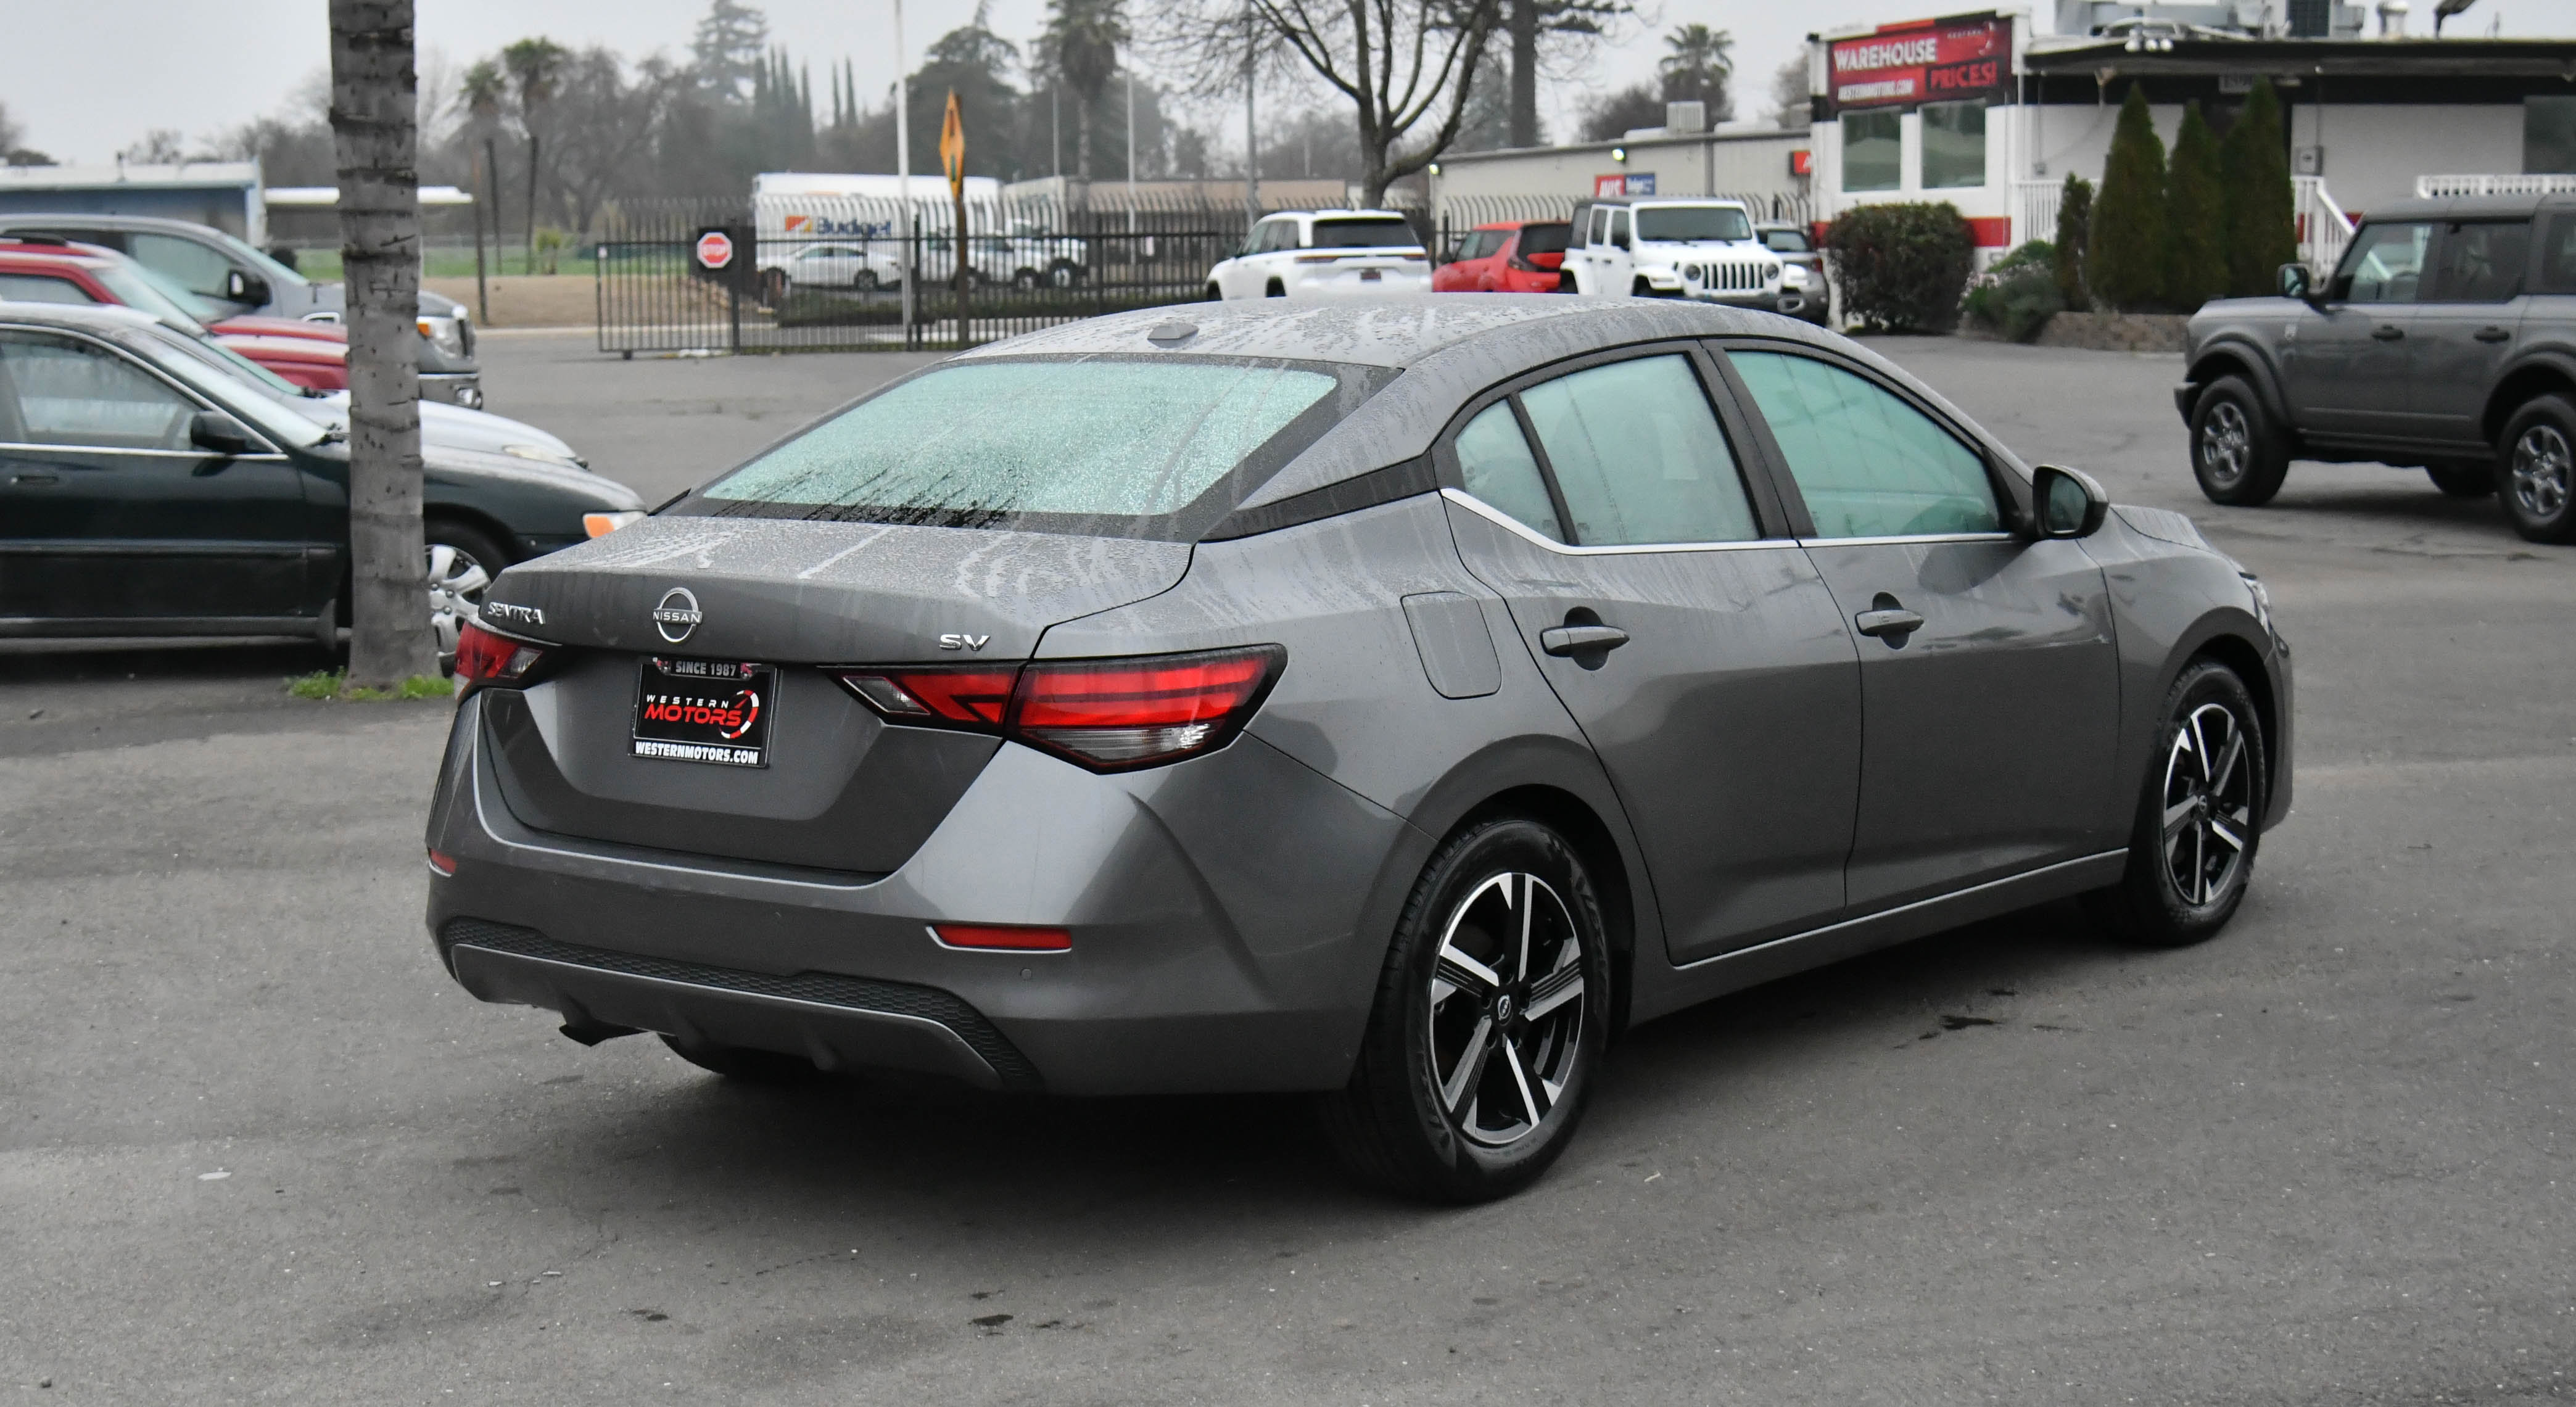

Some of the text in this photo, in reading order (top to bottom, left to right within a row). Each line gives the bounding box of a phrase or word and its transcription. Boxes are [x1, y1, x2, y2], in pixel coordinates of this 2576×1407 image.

[1834, 37, 1937, 73] WAREHOUSE
[1930, 61, 1997, 89] PRICES!
[1838, 79, 1915, 102] WESTERNMOTORS.COM
[817, 216, 892, 239] Budget
[488, 601, 546, 625] SENTRA
[652, 611, 701, 623] NISSAN
[939, 633, 991, 651] SV
[675, 661, 737, 677] SINCE 1987
[646, 694, 729, 709] WESTERN
[644, 703, 743, 727] MOTORS
[635, 741, 759, 765] WESTERNMOTORS.COM
